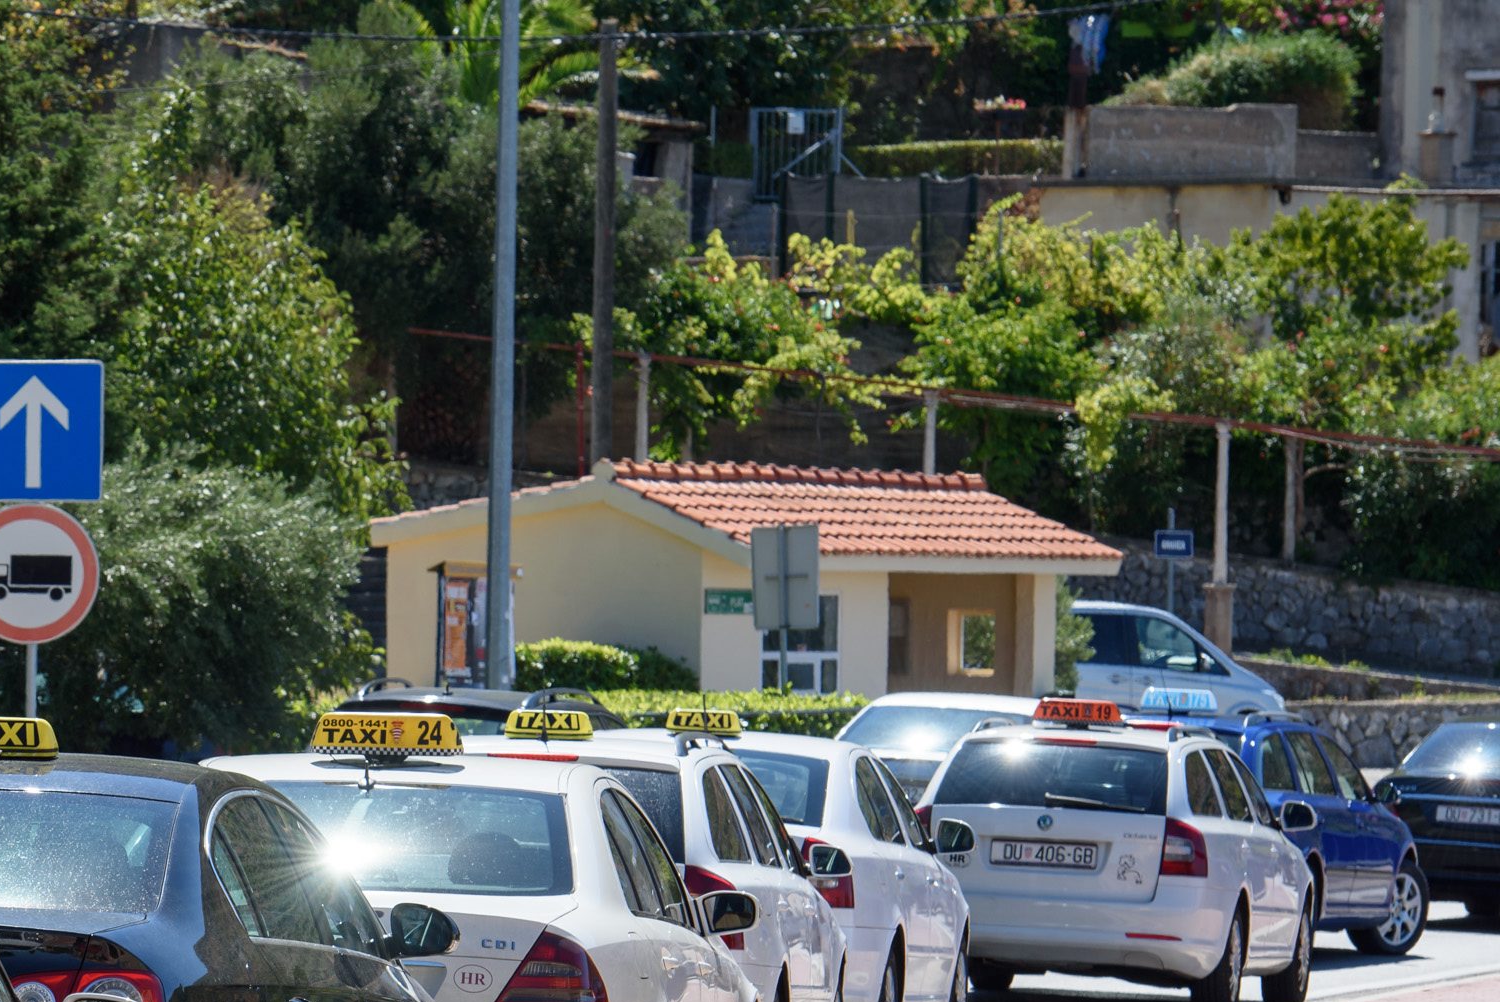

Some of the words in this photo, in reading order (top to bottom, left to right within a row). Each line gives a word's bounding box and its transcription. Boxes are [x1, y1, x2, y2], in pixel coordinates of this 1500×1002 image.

[676, 712, 730, 728] TAXI
[1040, 705, 1079, 717] TAXI
[1095, 704, 1112, 720] 19
[322, 719, 388, 728] 0800-1441
[519, 712, 579, 729] TAXI
[322, 728, 387, 744] TAXI
[417, 720, 442, 745] 24
[949, 853, 965, 863] HR
[1003, 843, 1022, 860] DU
[481, 939, 515, 950] CDI
[461, 972, 485, 985] HR
